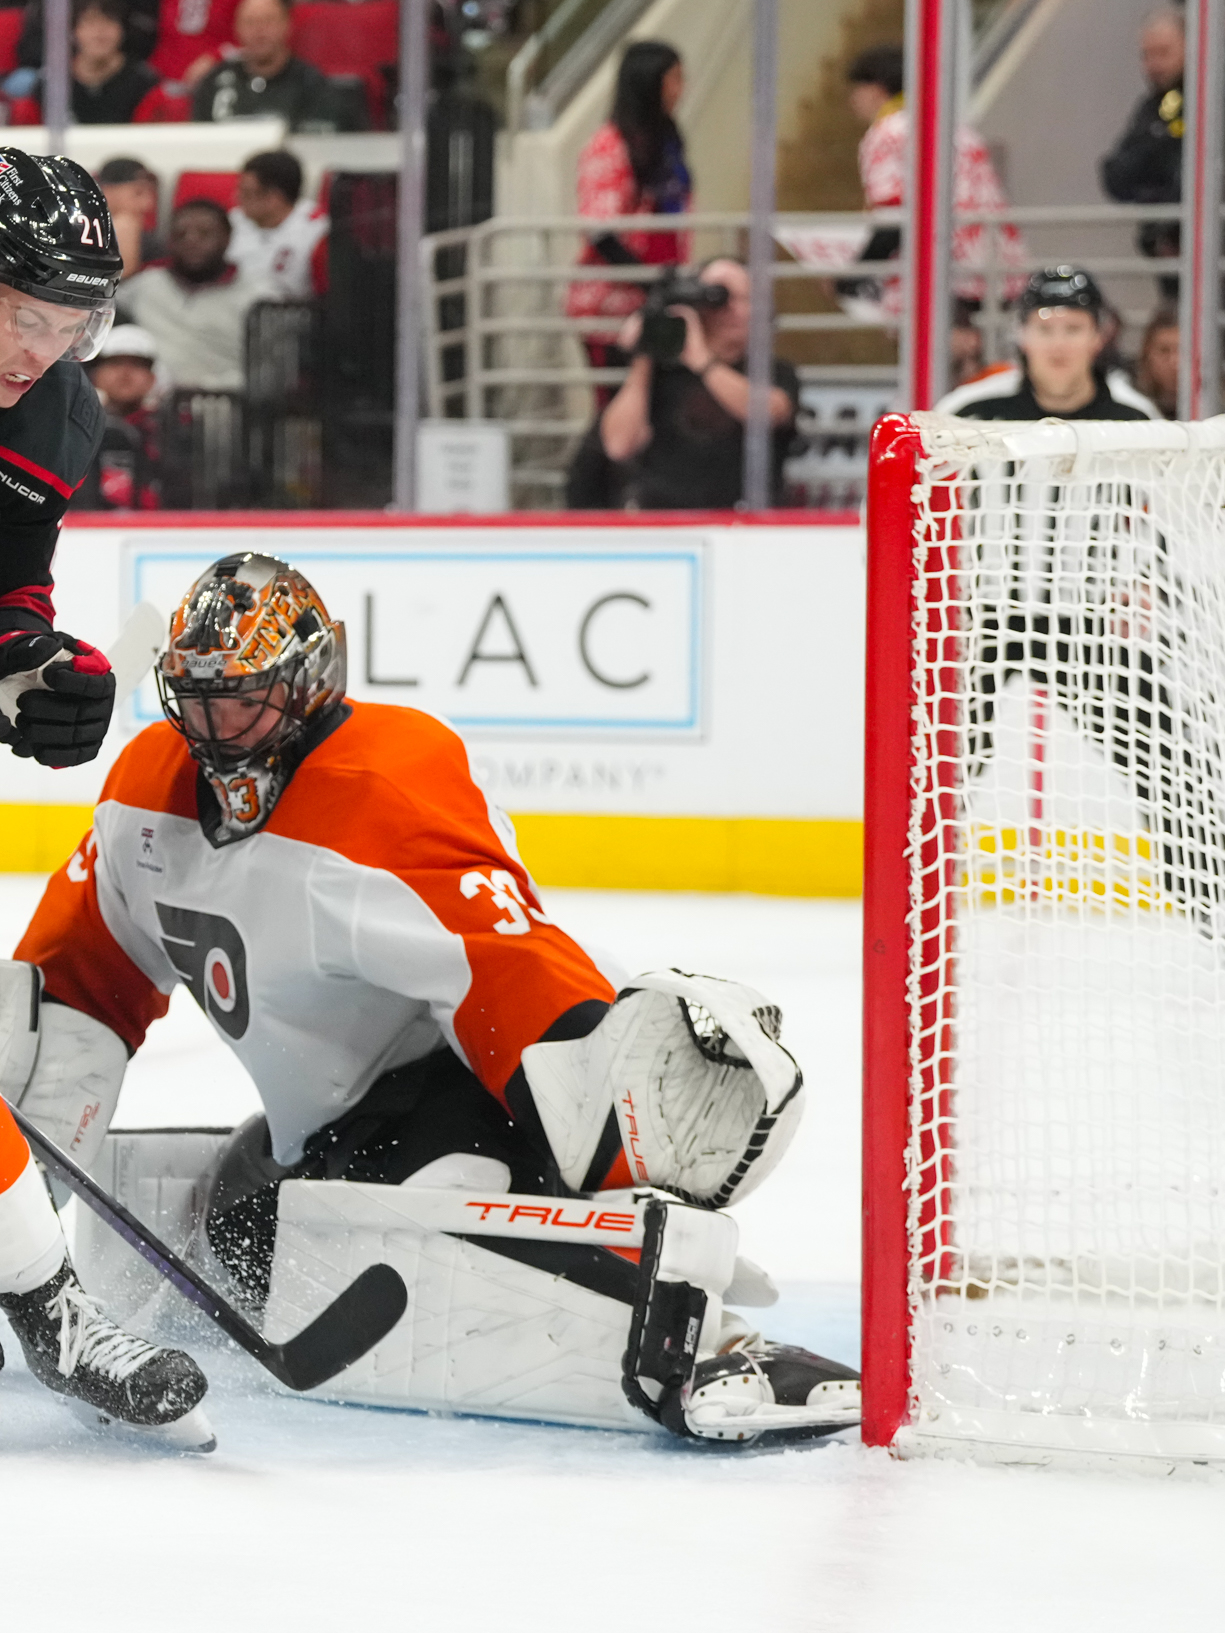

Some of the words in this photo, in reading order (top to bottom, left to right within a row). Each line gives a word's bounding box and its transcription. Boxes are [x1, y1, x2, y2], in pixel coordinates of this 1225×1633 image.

[6, 167, 24, 187] First
[77, 214, 103, 248] 21
[474, 757, 651, 791] OMPANY
[622, 1089, 650, 1182] TRUE
[465, 1201, 636, 1233] TRUE
